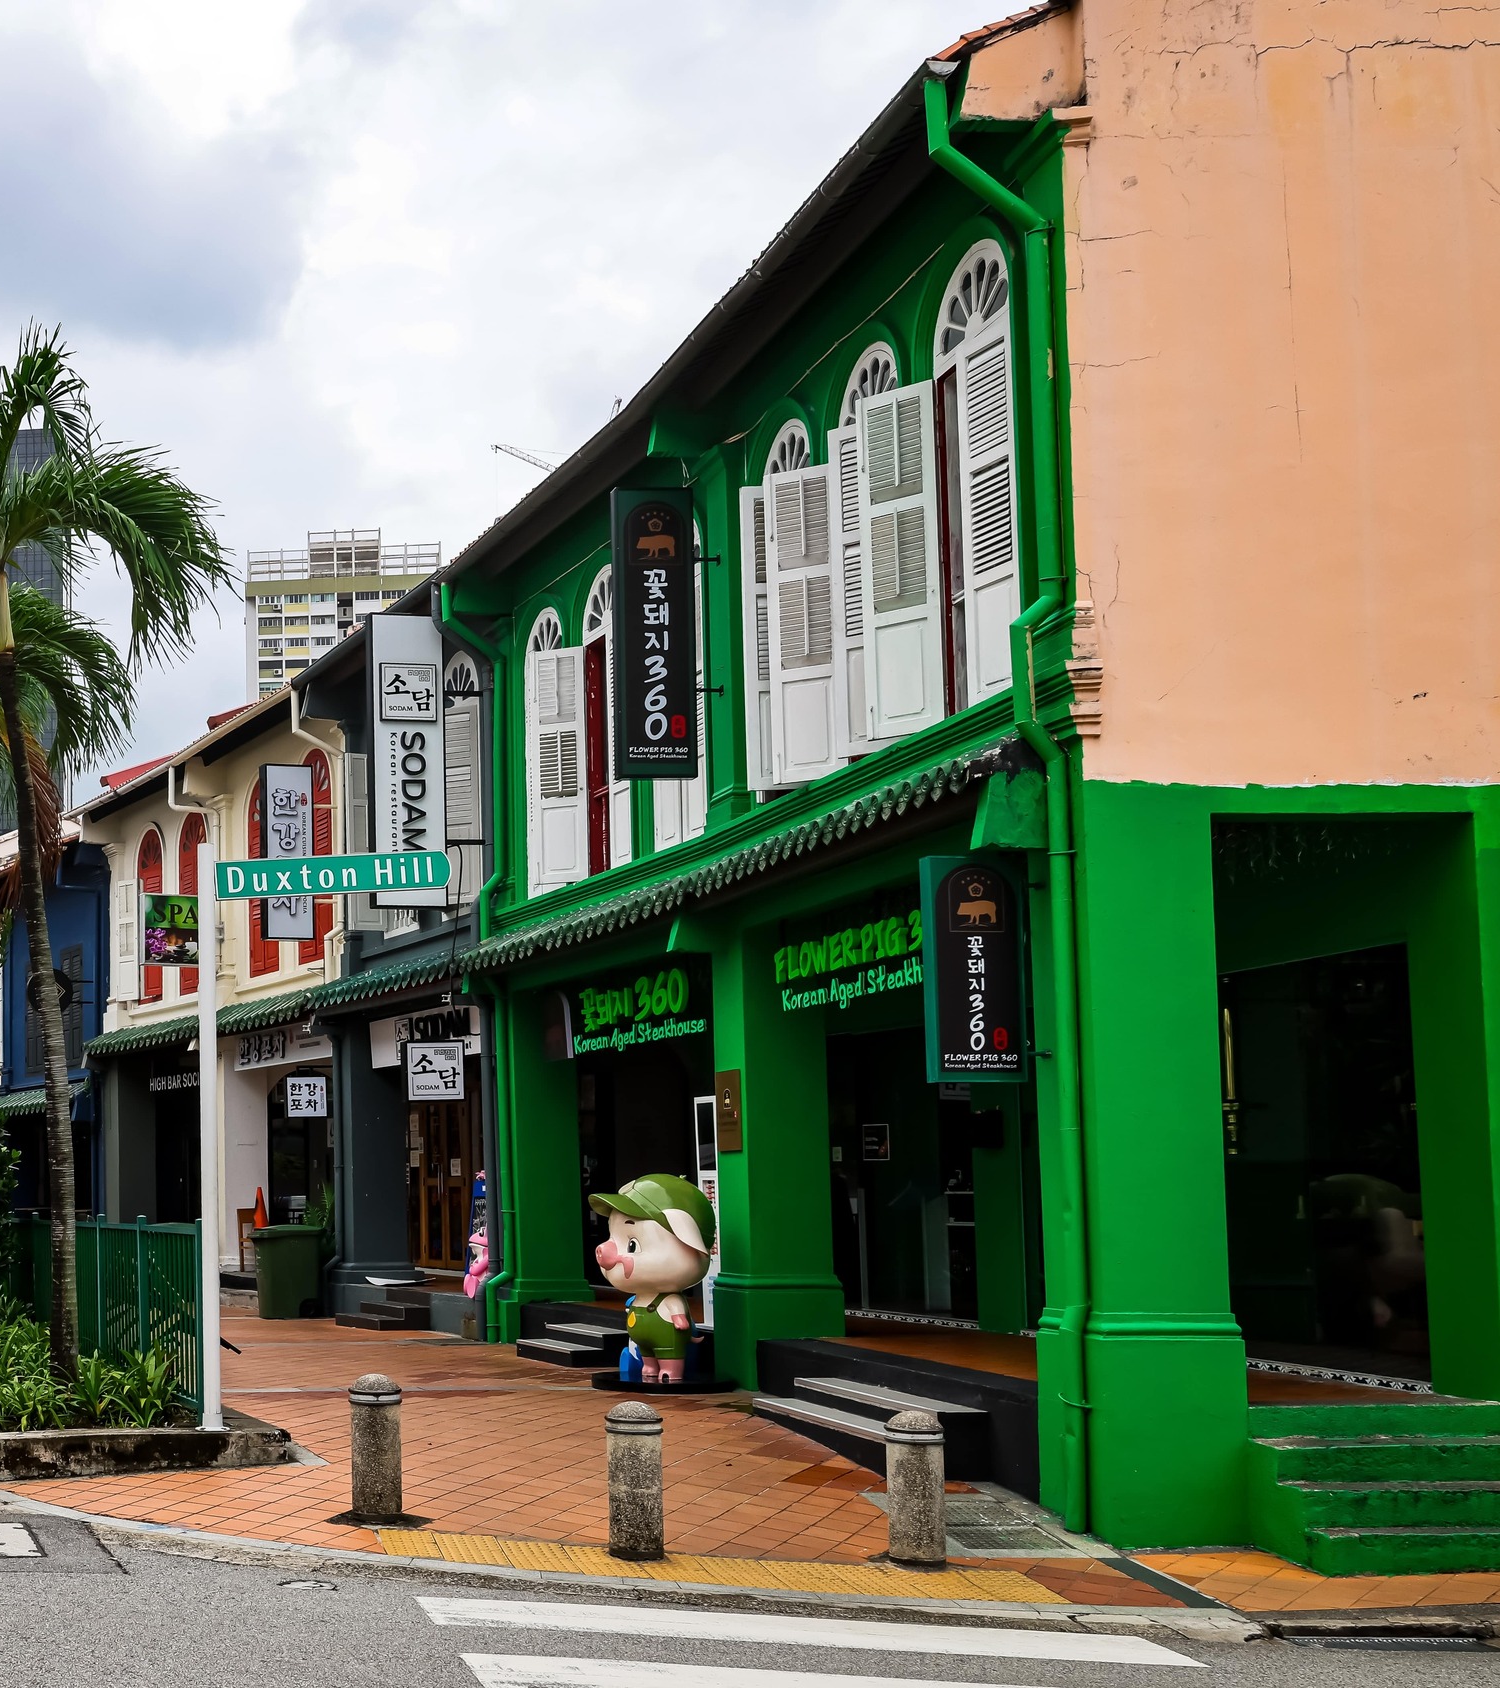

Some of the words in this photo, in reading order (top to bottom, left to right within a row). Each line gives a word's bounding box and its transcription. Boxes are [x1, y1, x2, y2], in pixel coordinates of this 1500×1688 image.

[384, 673, 435, 712] 소담
[390, 732, 398, 776] Korean
[400, 731, 427, 851] SODAM
[390, 783, 399, 852] restaurant
[272, 788, 300, 916] 한강차
[226, 864, 357, 894] Duxton
[374, 856, 434, 886] Hill
[153, 903, 198, 924] SPA
[774, 928, 859, 984] FLOWER
[860, 916, 908, 963] PIG
[634, 968, 688, 1022] 360
[781, 988, 828, 1012] Korean
[830, 971, 866, 1009] Aged
[867, 956, 923, 994] Steakh
[573, 1034, 610, 1055] Korean
[610, 1023, 637, 1052] Aged
[637, 1018, 706, 1043] Steakhouse
[411, 1054, 461, 1090] 소담
[944, 1053, 981, 1061] FLOWER
[982, 1053, 999, 1061] PIG
[150, 1076, 167, 1091] HIGH
[167, 1074, 182, 1090] BAR
[182, 1071, 200, 1087] SOCI
[289, 1082, 319, 1097] 한강
[289, 1098, 319, 1112] 포차
